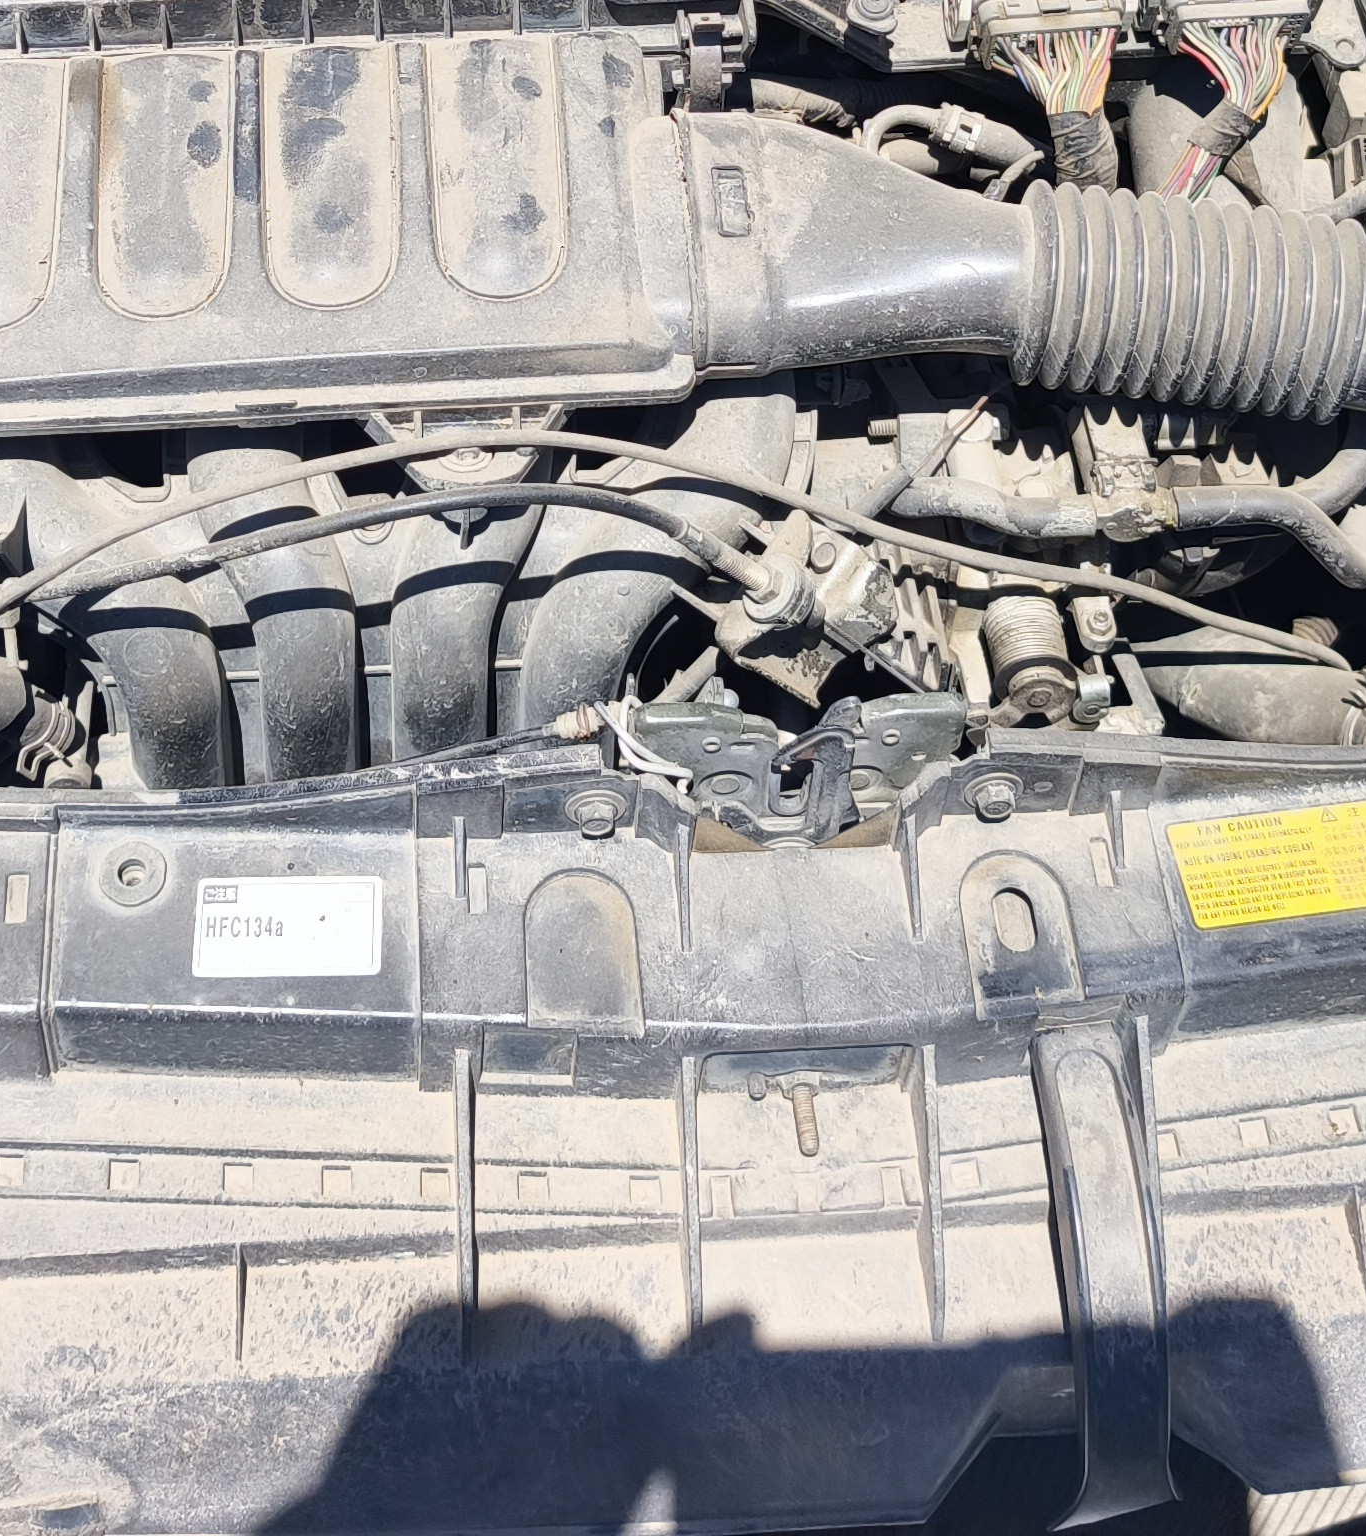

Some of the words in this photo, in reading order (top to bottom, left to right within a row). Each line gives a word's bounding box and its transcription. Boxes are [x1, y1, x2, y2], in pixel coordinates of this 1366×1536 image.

[1196, 825, 1222, 836] FAN
[1227, 815, 1283, 832] CAUTION
[205, 915, 284, 939] HFC134a
